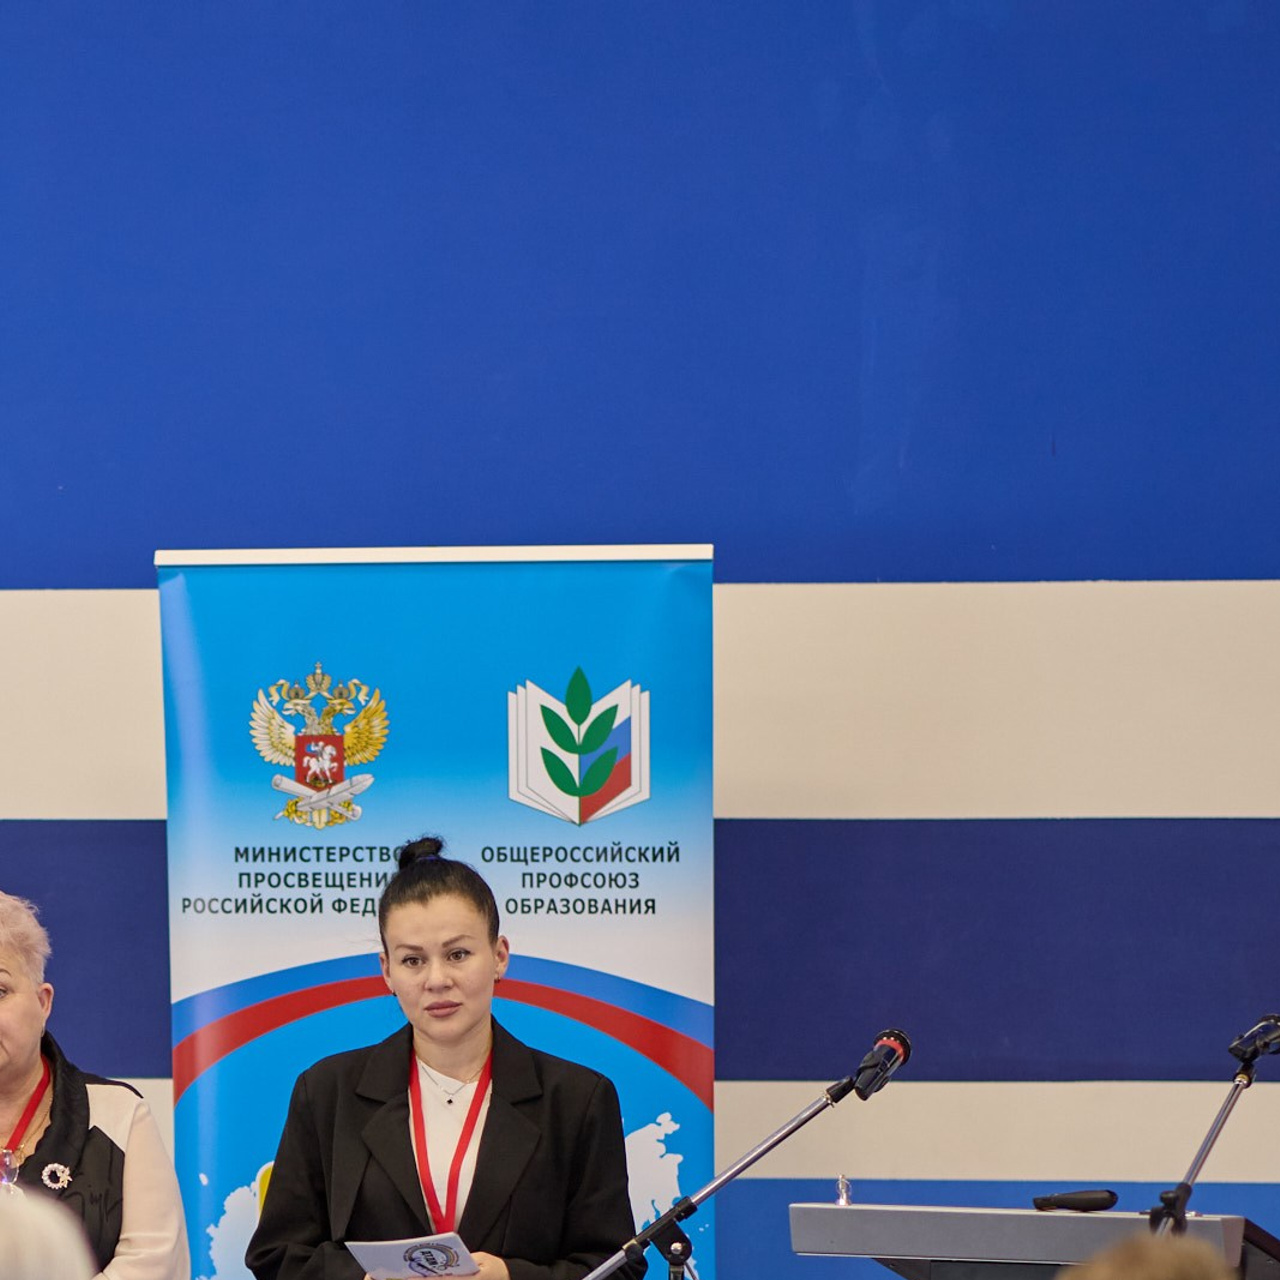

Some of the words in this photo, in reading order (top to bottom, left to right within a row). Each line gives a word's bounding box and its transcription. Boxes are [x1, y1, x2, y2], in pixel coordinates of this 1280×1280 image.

[481, 842, 680, 865] ОБЩЕРОССИЙСКИЙ
[238, 872, 388, 890] ПРОСВЕЩЕНИ
[522, 872, 640, 889] ПРОФСОЮЗ
[182, 893, 323, 915] РОССИЙСКОЙ
[331, 898, 377, 917] ФЕД
[505, 898, 656, 915] ОБРАЗОВАНИЯ
